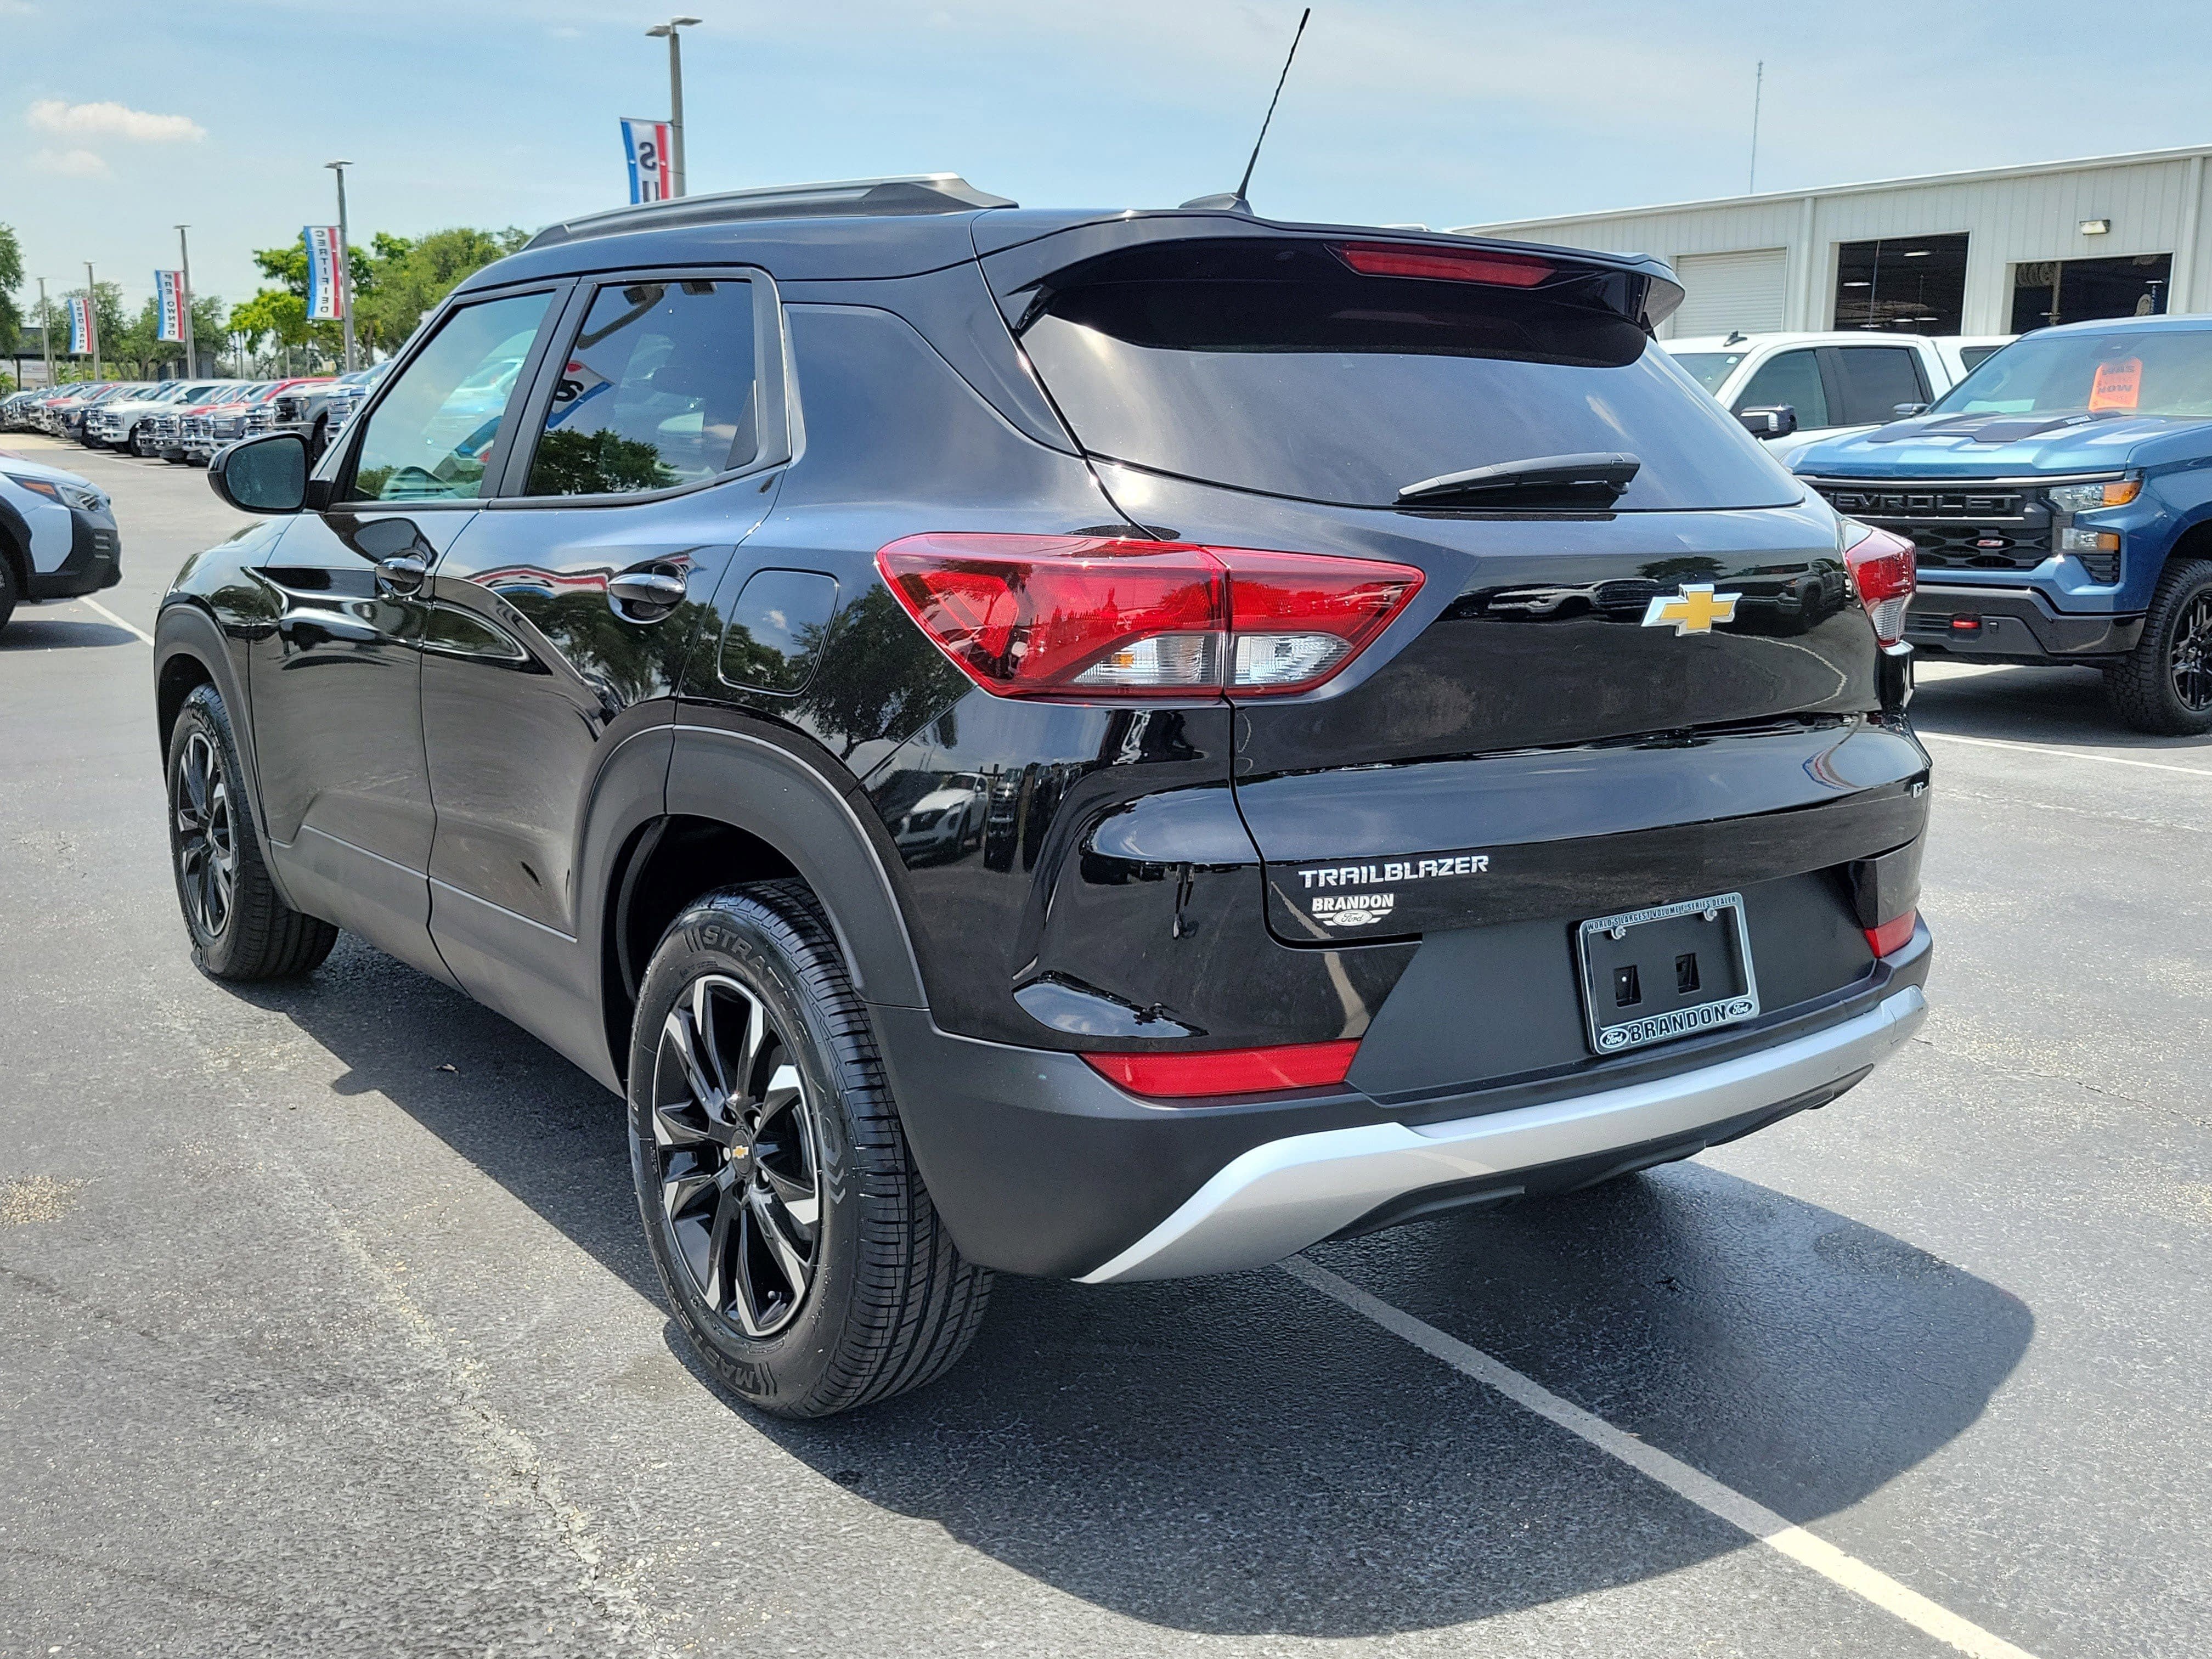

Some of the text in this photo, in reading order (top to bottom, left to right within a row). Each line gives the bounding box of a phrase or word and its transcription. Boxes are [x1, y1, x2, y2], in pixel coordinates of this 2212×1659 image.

[1825, 493, 2022, 510] HEVROLET
[1298, 855, 1489, 888] TRAILBLAZER
[1312, 893, 1394, 911] BRANDON
[1621, 911, 1651, 924] LARGEST
[1653, 905, 1679, 918] VOLUME
[1712, 895, 1736, 907] DEALER
[1340, 912, 1364, 924] Ford
[1605, 1002, 1750, 1045] Ford BRANDON Ford
